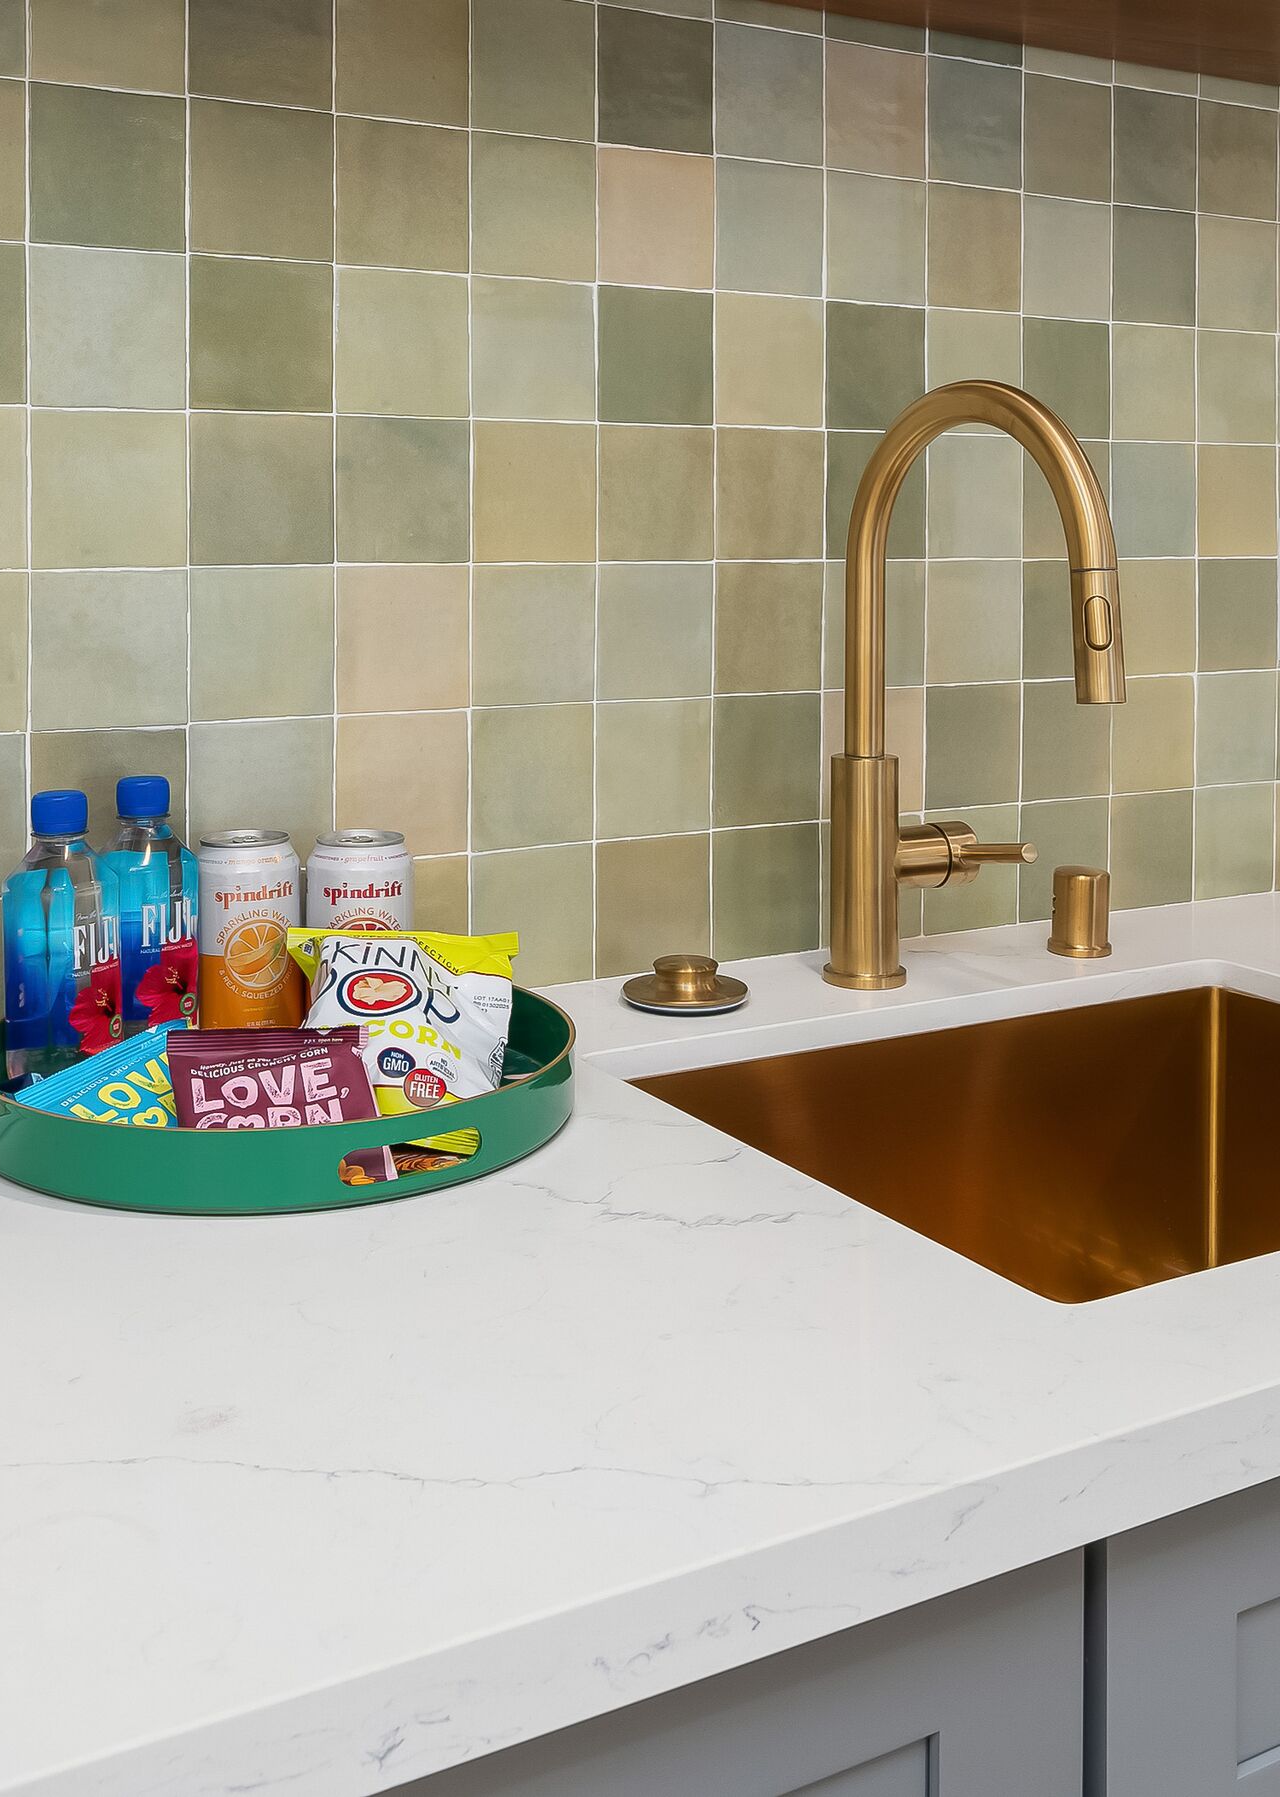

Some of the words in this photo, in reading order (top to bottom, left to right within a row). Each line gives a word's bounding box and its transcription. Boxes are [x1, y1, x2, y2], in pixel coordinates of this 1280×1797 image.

[344, 854, 384, 864] grapefruit
[215, 881, 293, 909] spindrift
[323, 881, 402, 906] spindrift
[141, 898, 193, 948] FIJI
[216, 908, 270, 945] SPARKLING
[272, 909, 294, 928] WAT
[327, 906, 375, 930] ARKLING
[378, 908, 402, 932] WATE
[73, 915, 119, 971] FIJI
[222, 975, 240, 994] REAL
[241, 983, 284, 1000] SQUEEZED
[190, 1062, 245, 1079] DELICIOUS
[247, 1055, 297, 1069] CRUNCHY
[299, 1047, 329, 1059] CORN
[383, 1058, 410, 1072] GMO
[390, 1051, 405, 1060] NON
[409, 1081, 441, 1100] FREE
[414, 1072, 440, 1084] GLUTEN
[60, 1075, 110, 1107] DELICIOUS
